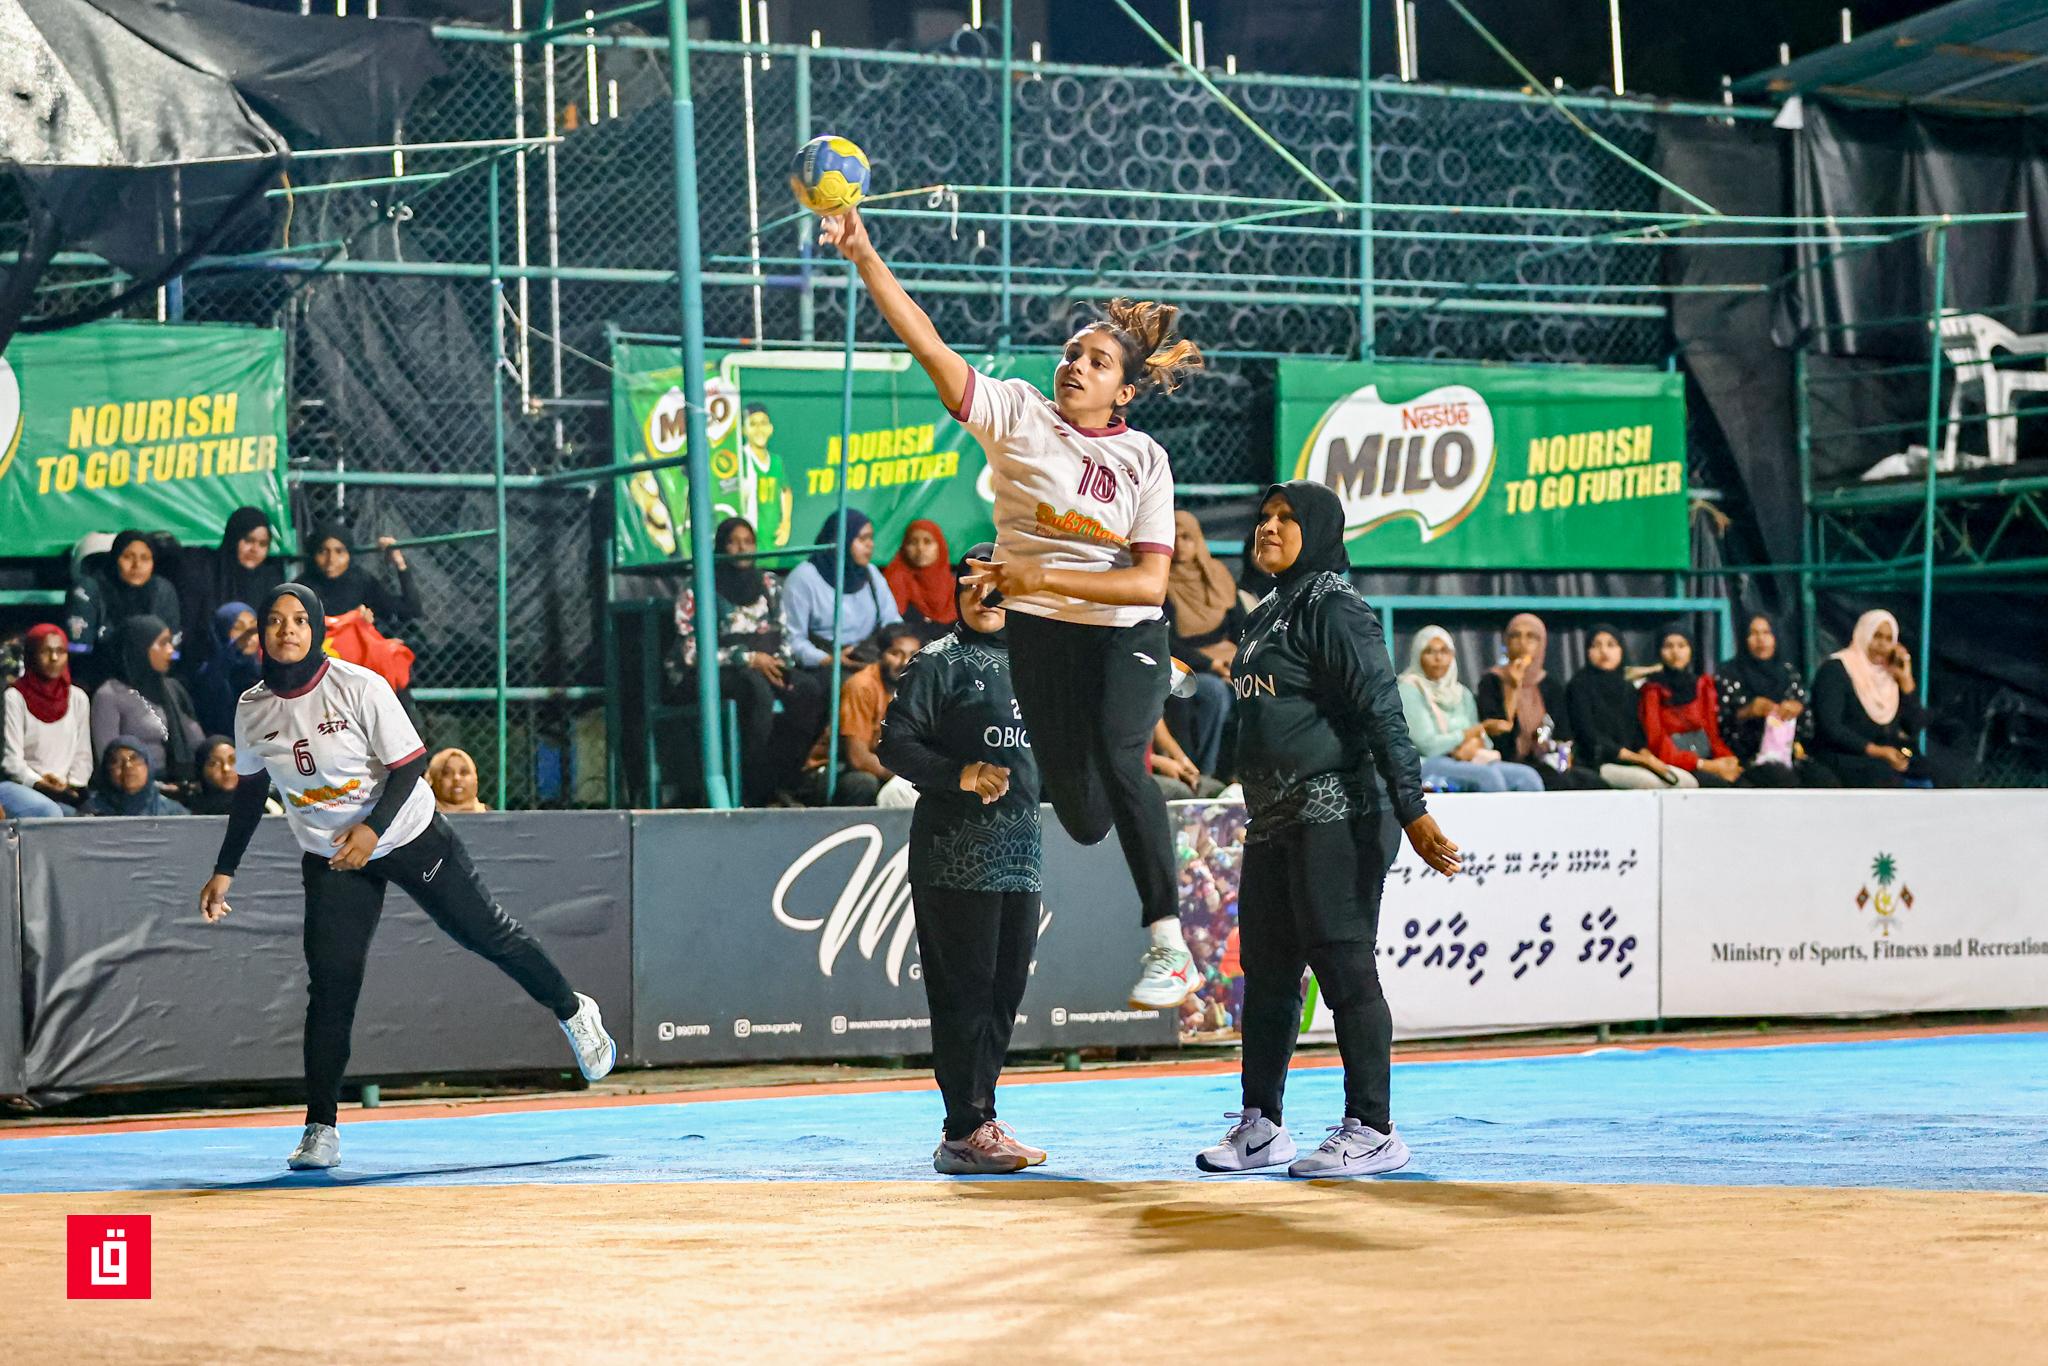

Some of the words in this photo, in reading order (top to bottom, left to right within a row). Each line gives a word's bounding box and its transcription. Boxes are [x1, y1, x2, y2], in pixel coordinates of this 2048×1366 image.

[68, 391, 238, 450] NOURISH
[659, 397, 730, 443] MO
[37, 454, 79, 495] TO
[84, 449, 132, 490] GO
[135, 434, 279, 485] FURTHER
[826, 423, 935, 466] NOURISH
[1324, 430, 1476, 502] MILO
[1527, 425, 1653, 476] NOURISH
[806, 466, 836, 496] TO
[869, 451, 960, 489] FURTHER
[1076, 455, 1118, 505] 10
[1505, 480, 1538, 514] TO
[1540, 474, 1575, 509] GO
[1577, 461, 1683, 506] FURTHER
[1233, 673, 1276, 701] BION
[292, 738, 317, 776] 6
[983, 725, 1032, 749] OBIO
[1711, 942, 1783, 967] Ministry
[1788, 942, 1807, 962] of
[1810, 942, 1868, 966] Sports,
[1873, 940, 1930, 961] Fitness
[1933, 941, 1963, 958] and
[1967, 938, 2048, 957] Recreation
